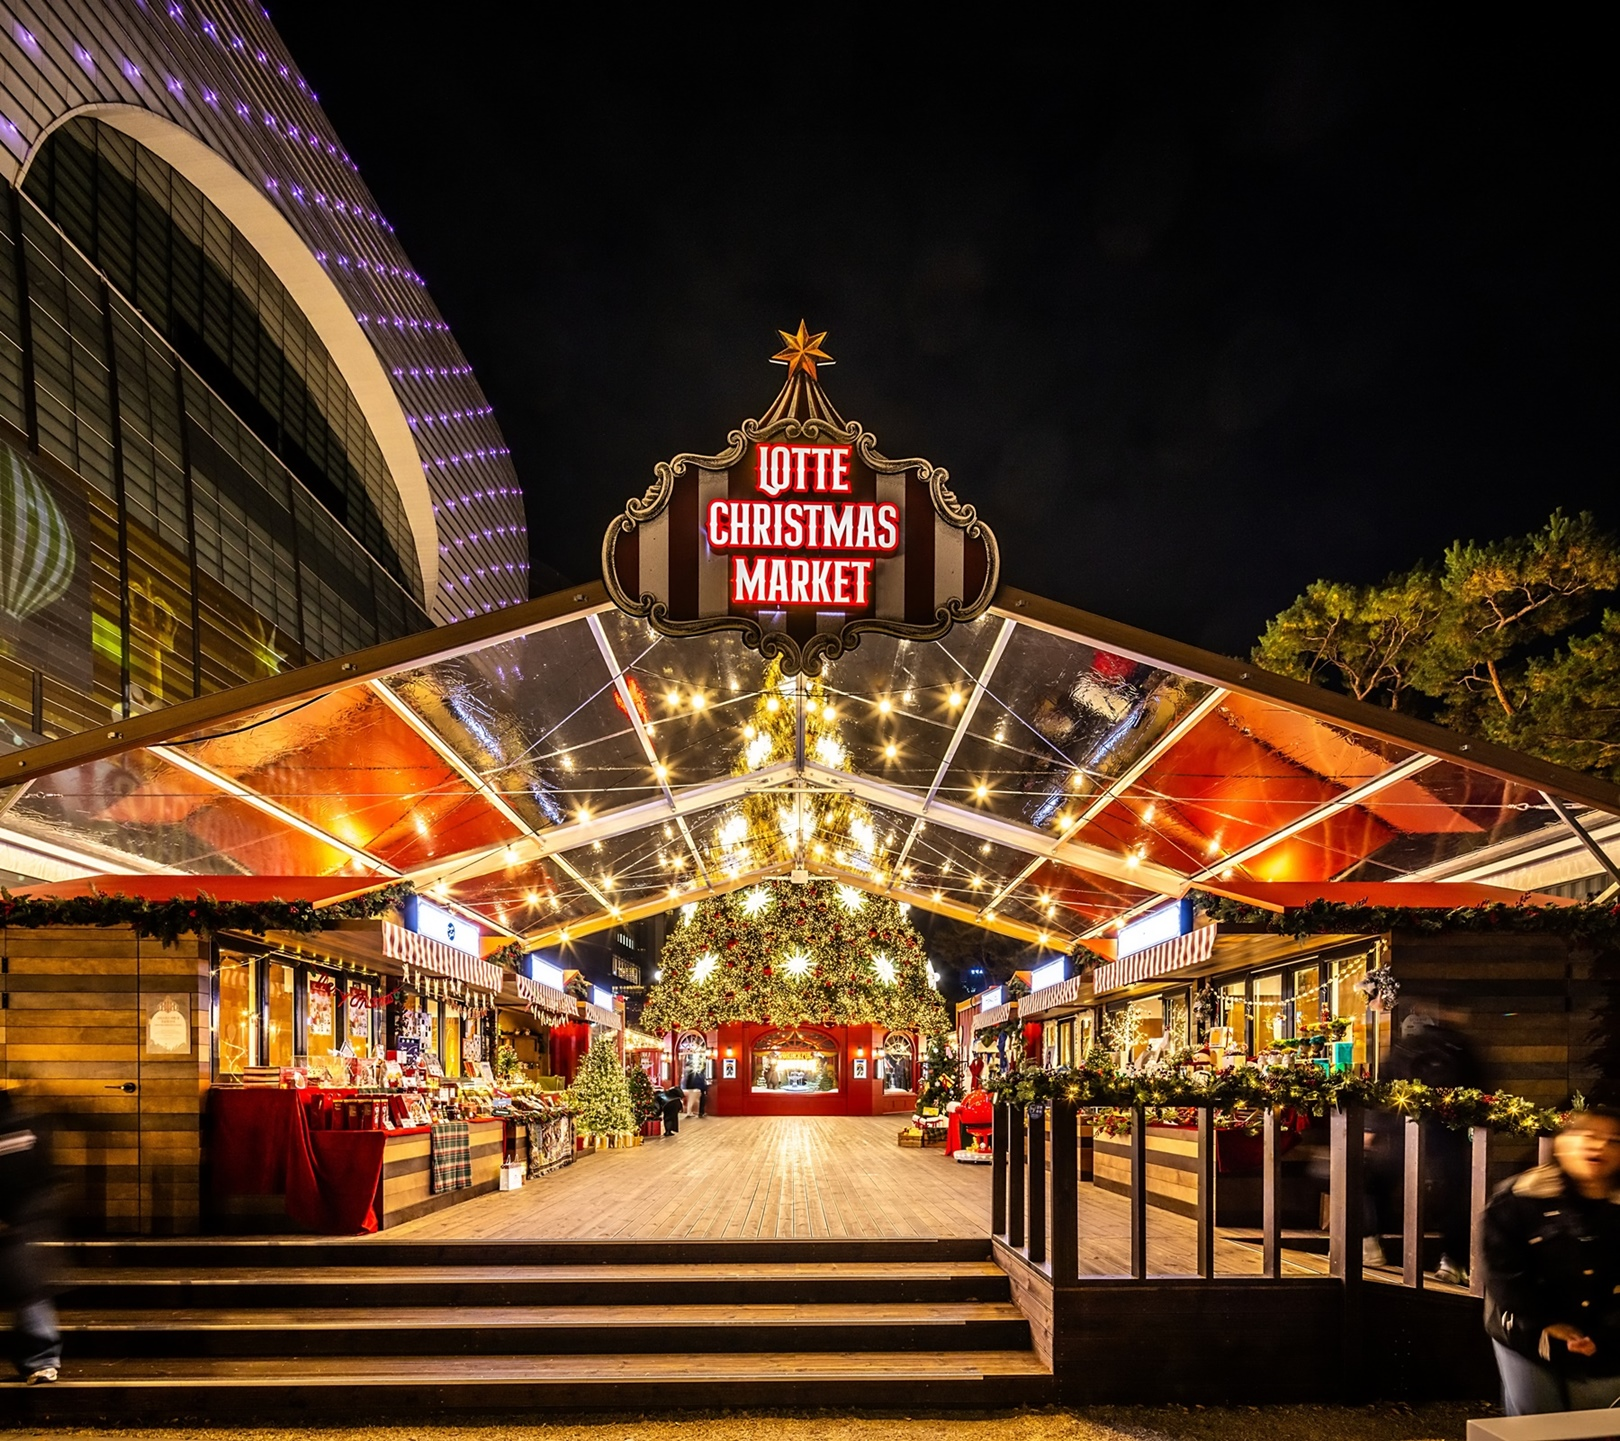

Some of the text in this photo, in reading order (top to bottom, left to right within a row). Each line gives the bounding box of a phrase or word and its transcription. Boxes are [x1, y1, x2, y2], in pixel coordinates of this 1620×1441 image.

[757, 446, 850, 495] LOTTE
[709, 501, 898, 549] CHRISTMAS
[733, 558, 871, 604] MARKET
